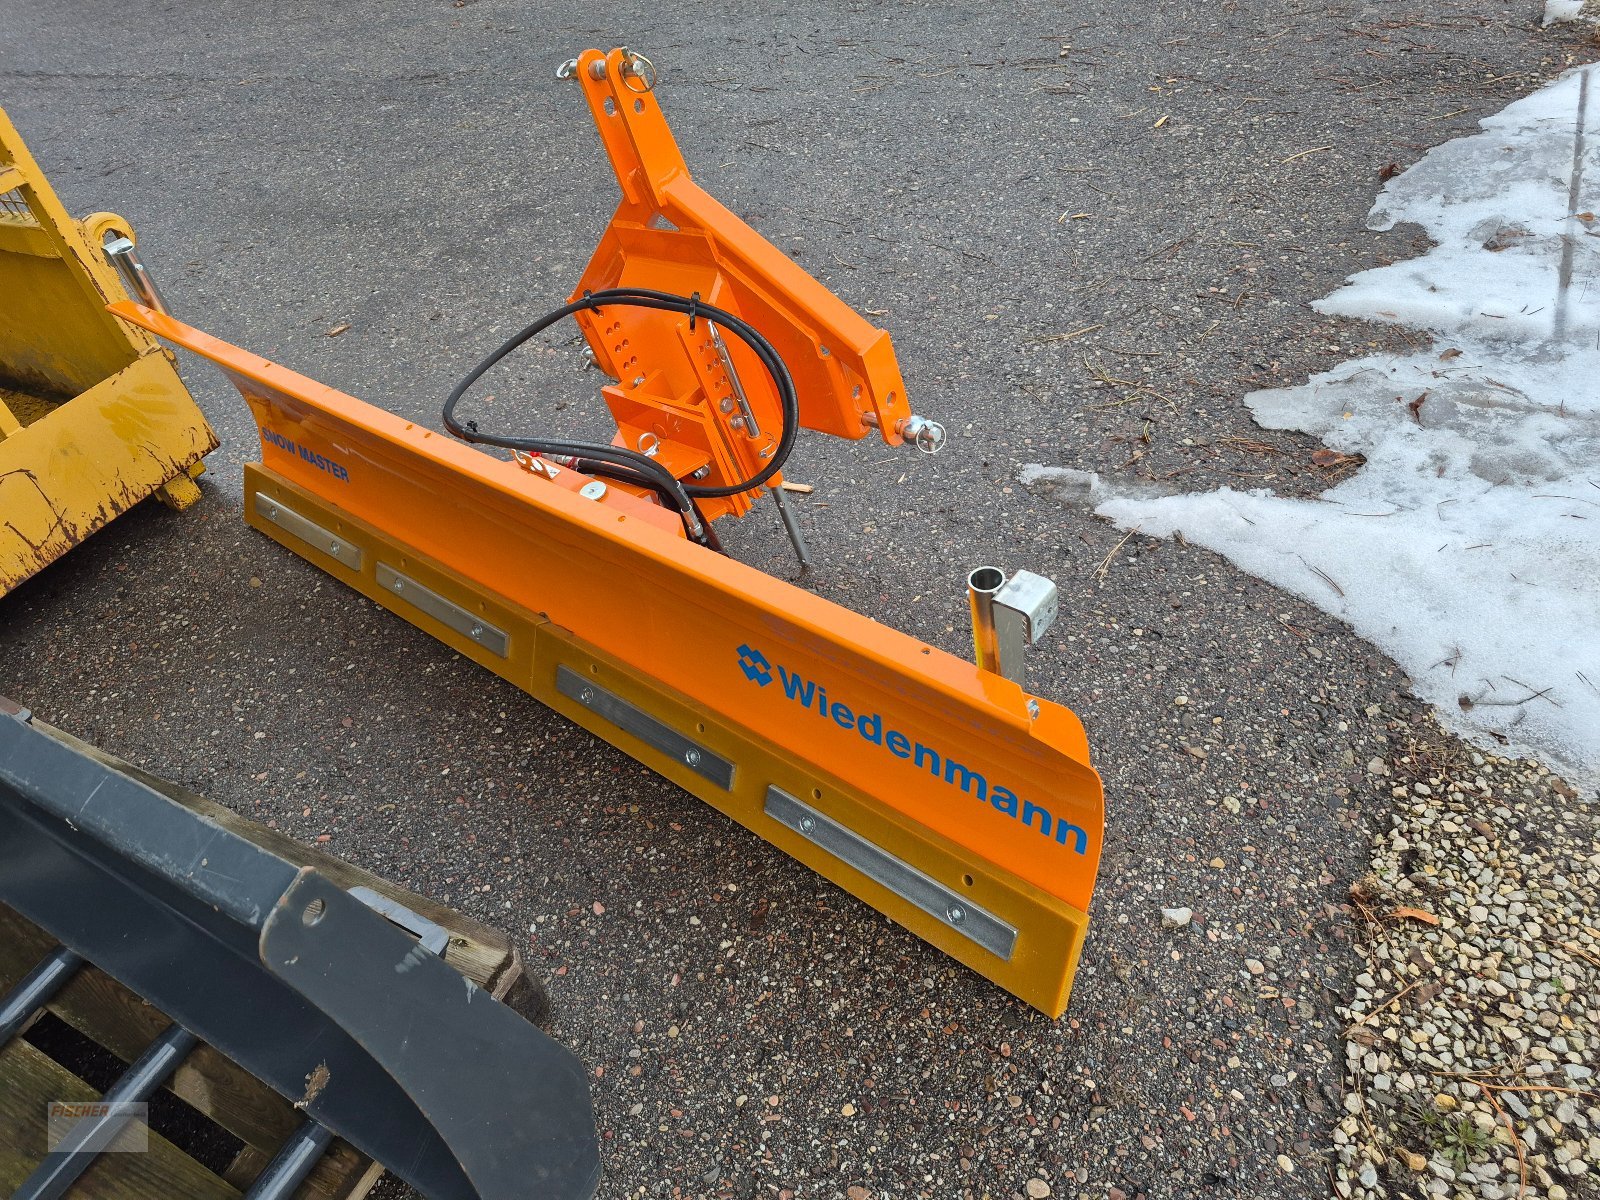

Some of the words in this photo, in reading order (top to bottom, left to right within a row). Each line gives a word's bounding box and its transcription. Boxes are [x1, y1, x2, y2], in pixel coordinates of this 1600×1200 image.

[262, 426, 296, 455] SNOW
[298, 445, 350, 484] MASTER
[777, 665, 1088, 855] Wiedenmann
